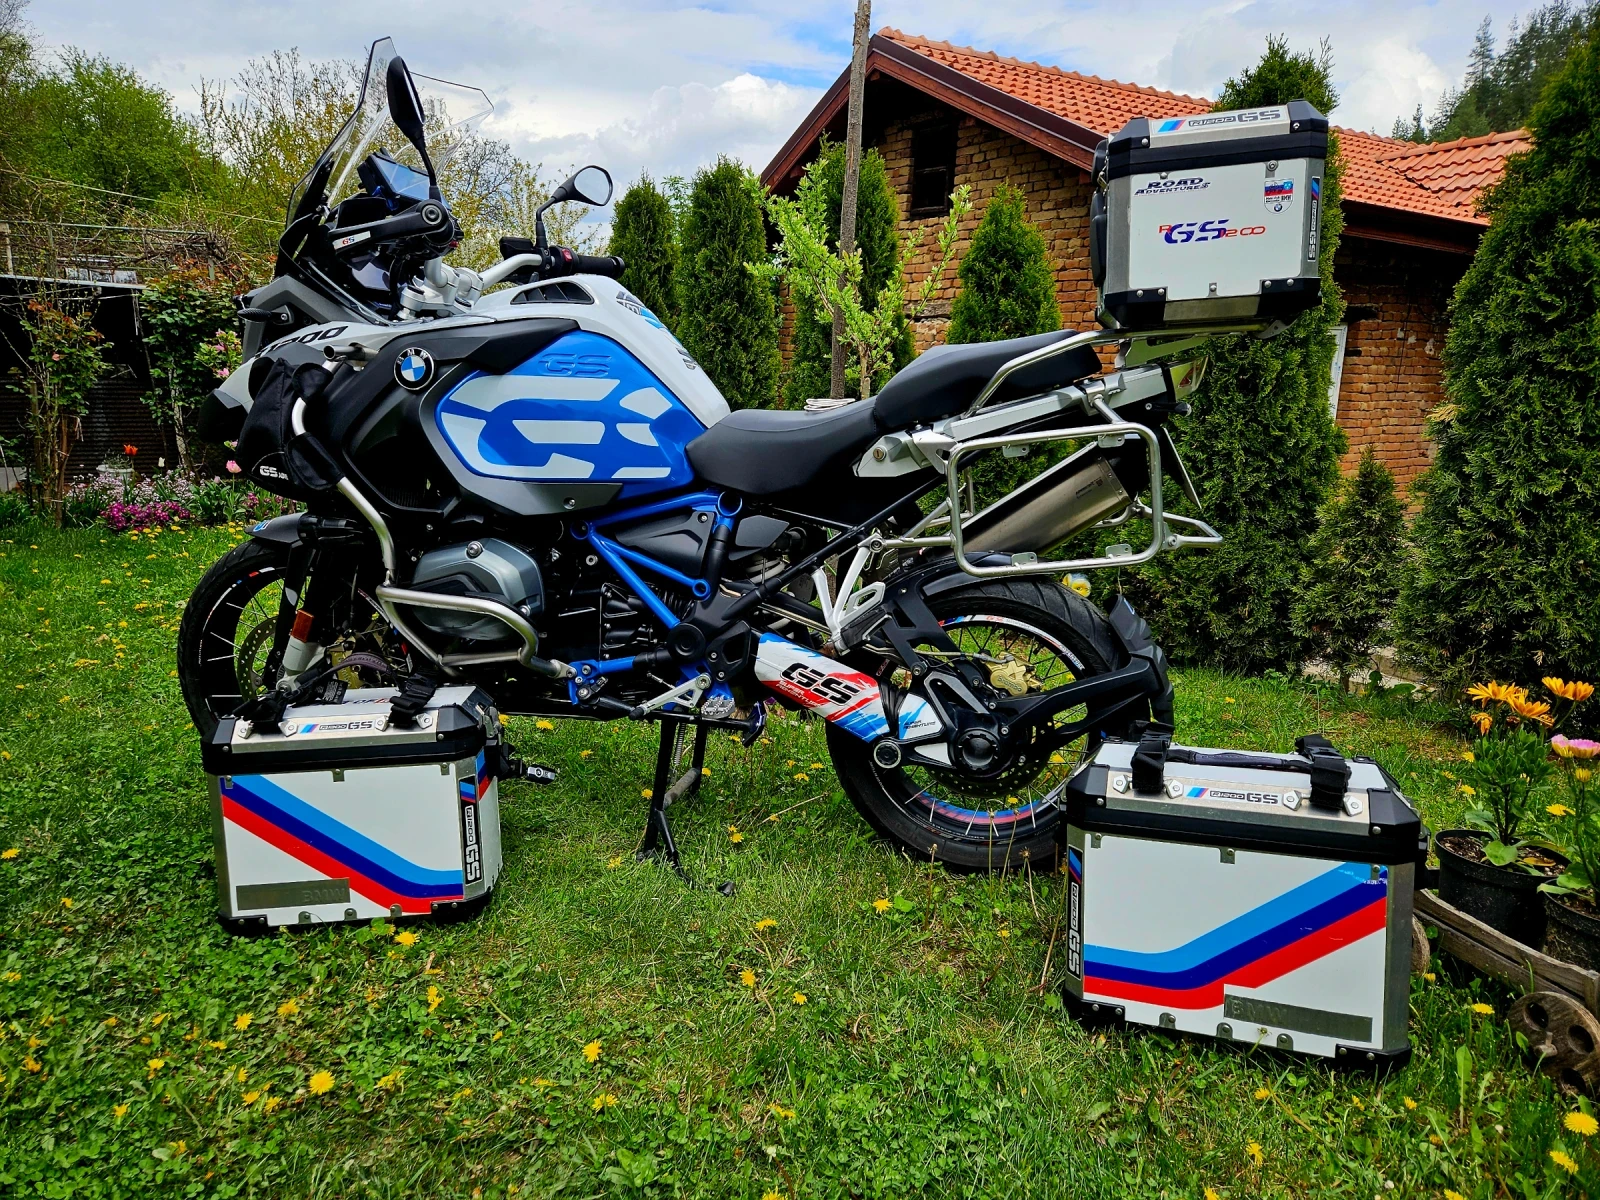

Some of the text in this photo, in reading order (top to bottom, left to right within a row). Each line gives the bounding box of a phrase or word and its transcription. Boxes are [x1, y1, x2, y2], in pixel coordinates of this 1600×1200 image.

[1148, 177, 1204, 190] ROAD
[342, 236, 355, 245] GS
[537, 353, 613, 377] GS
[259, 465, 279, 478] GS
[780, 662, 861, 706] GS
